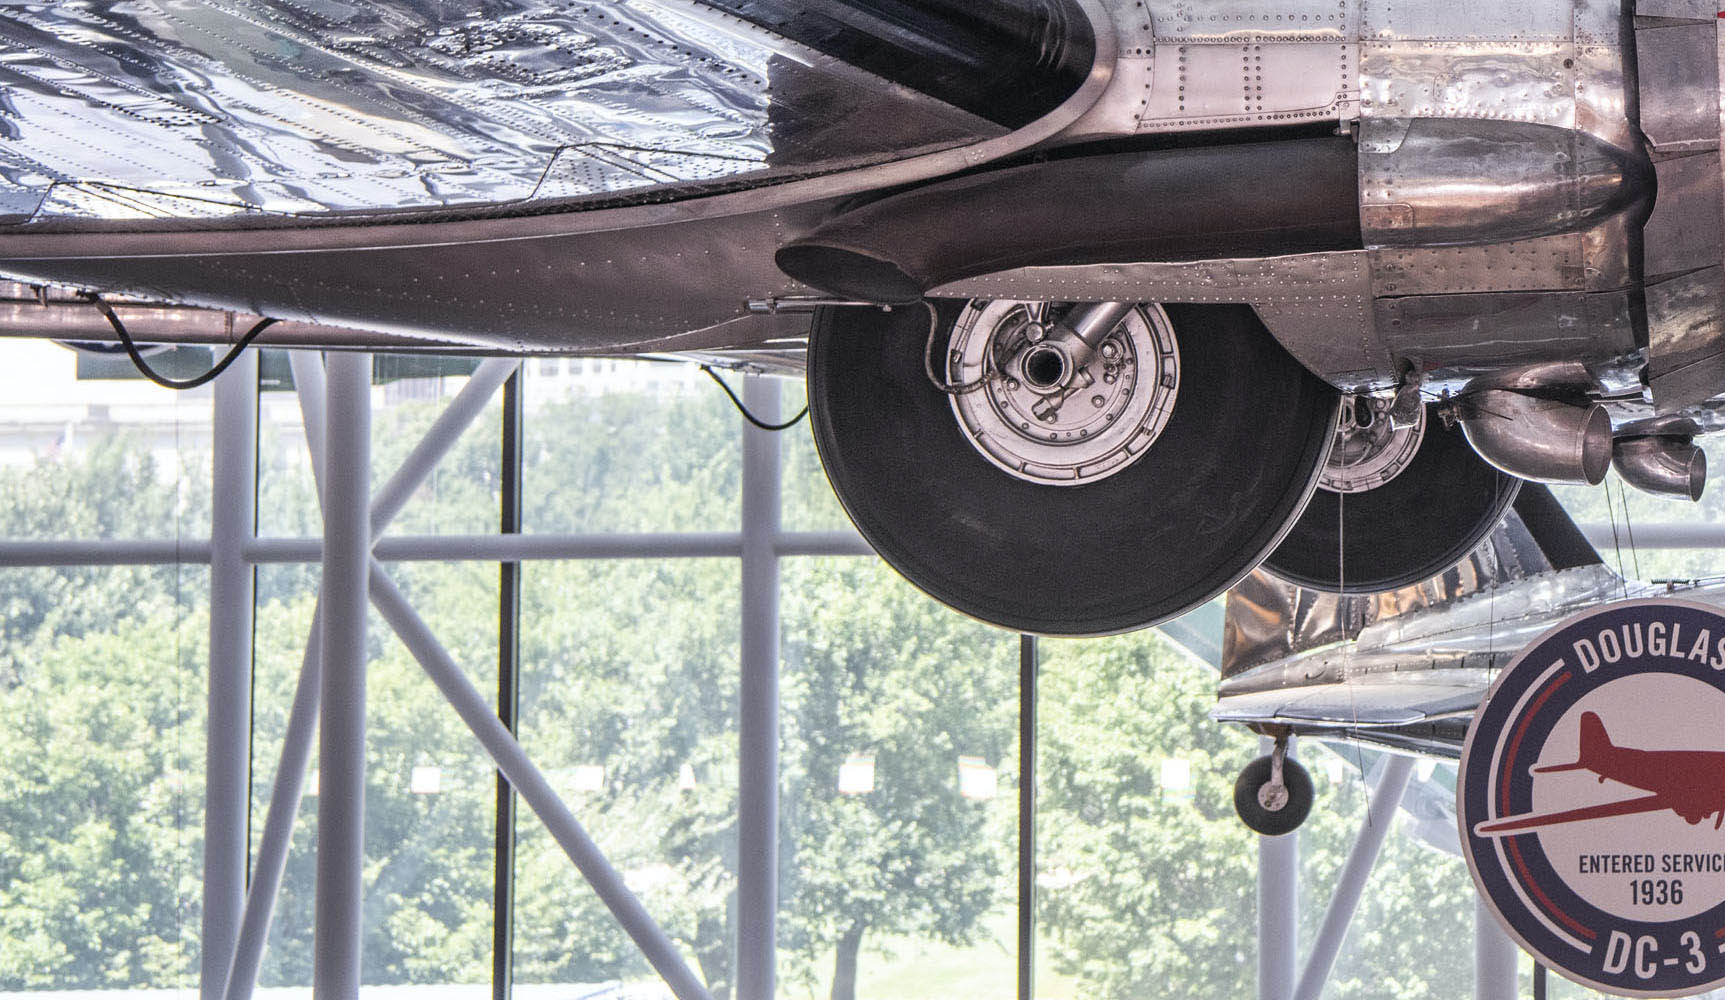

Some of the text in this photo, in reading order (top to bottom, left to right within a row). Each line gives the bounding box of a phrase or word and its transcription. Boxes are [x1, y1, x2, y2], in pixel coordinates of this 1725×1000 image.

[1579, 854, 1655, 873] ENTERED
[1629, 879, 1684, 905] 1936
[1602, 930, 1706, 979] DC-3
